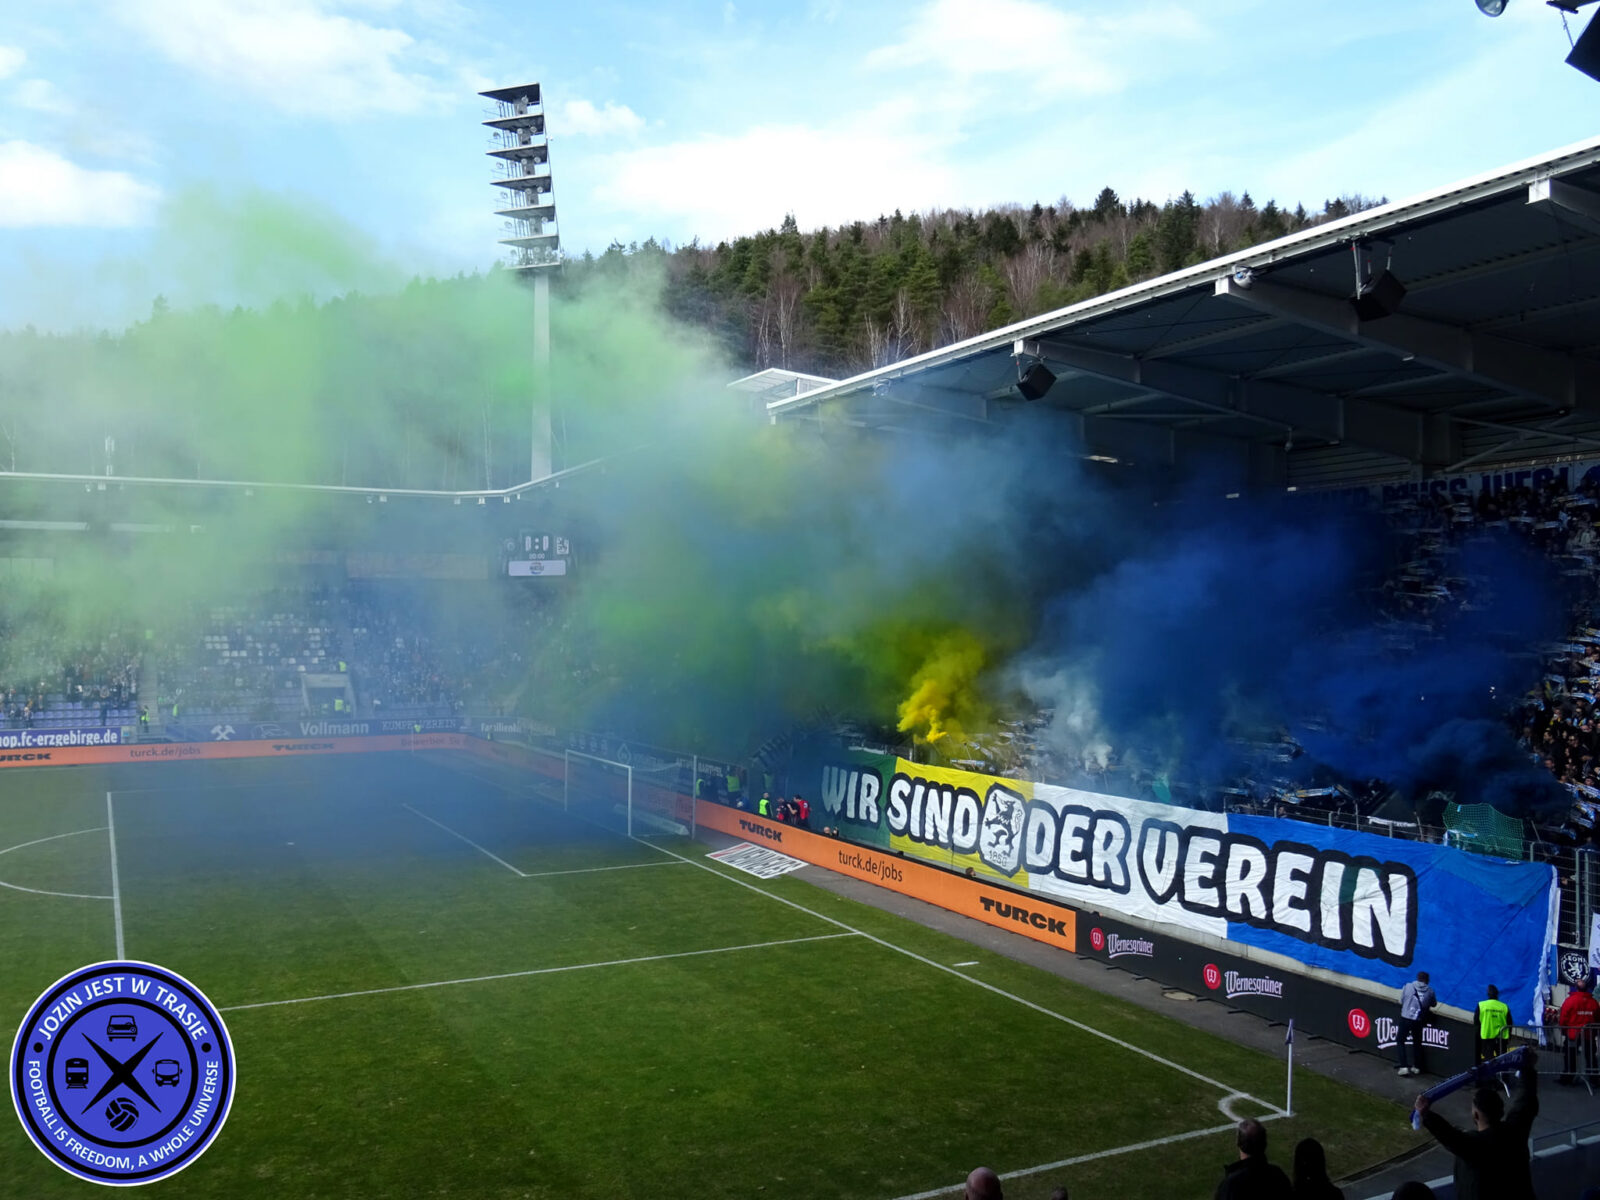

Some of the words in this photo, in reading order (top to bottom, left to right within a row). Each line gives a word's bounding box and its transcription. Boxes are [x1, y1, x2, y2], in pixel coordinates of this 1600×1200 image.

[300, 721, 369, 736] Vollmann
[130, 747, 201, 758] turck.de/jobs
[272, 743, 335, 751] TURCK
[739, 819, 782, 843] TURCK
[819, 763, 882, 826] WIR
[887, 772, 982, 850] SIND
[1024, 801, 1131, 893] DER
[1138, 820, 1417, 966] VEREIN
[838, 849, 903, 884] turck.de/jobs
[980, 897, 1067, 937] TURCK
[1107, 933, 1154, 955] Wernesgrüner
[1224, 970, 1283, 997] Wernesgrüner
